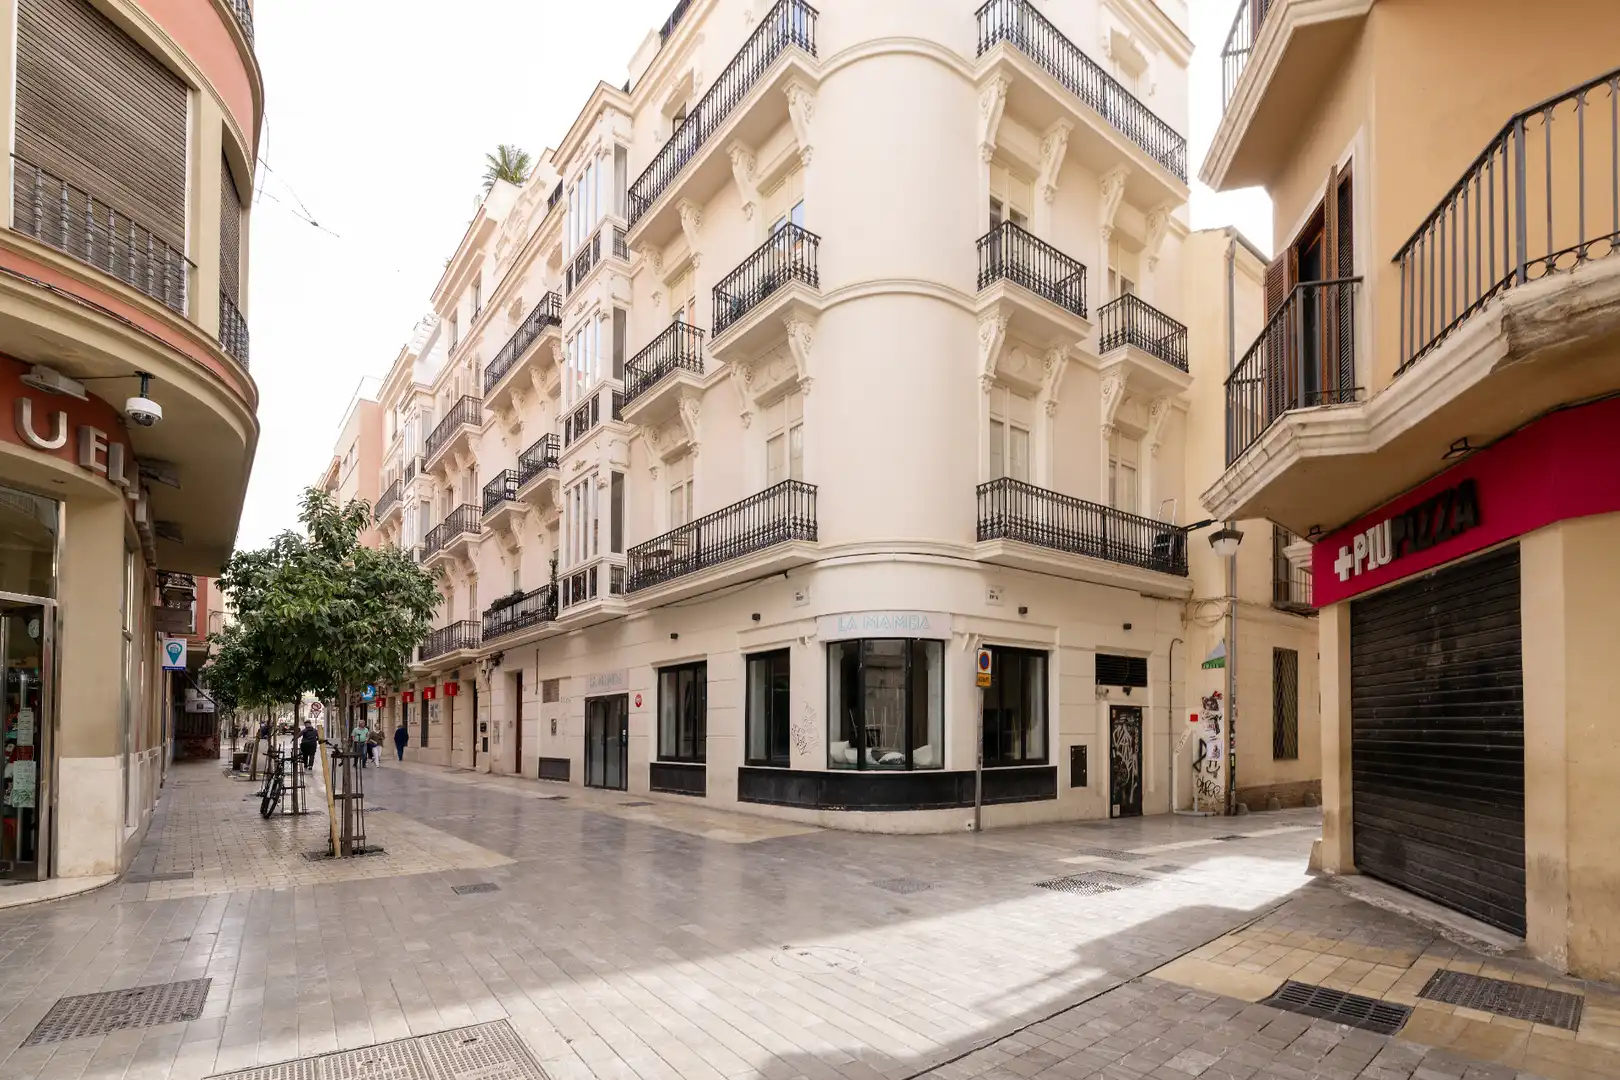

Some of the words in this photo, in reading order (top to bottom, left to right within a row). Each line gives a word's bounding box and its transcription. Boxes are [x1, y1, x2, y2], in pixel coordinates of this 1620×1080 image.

[1392, 479, 1481, 559] PIZZA
[838, 615, 858, 632] LA
[863, 614, 931, 631] MAMBA
